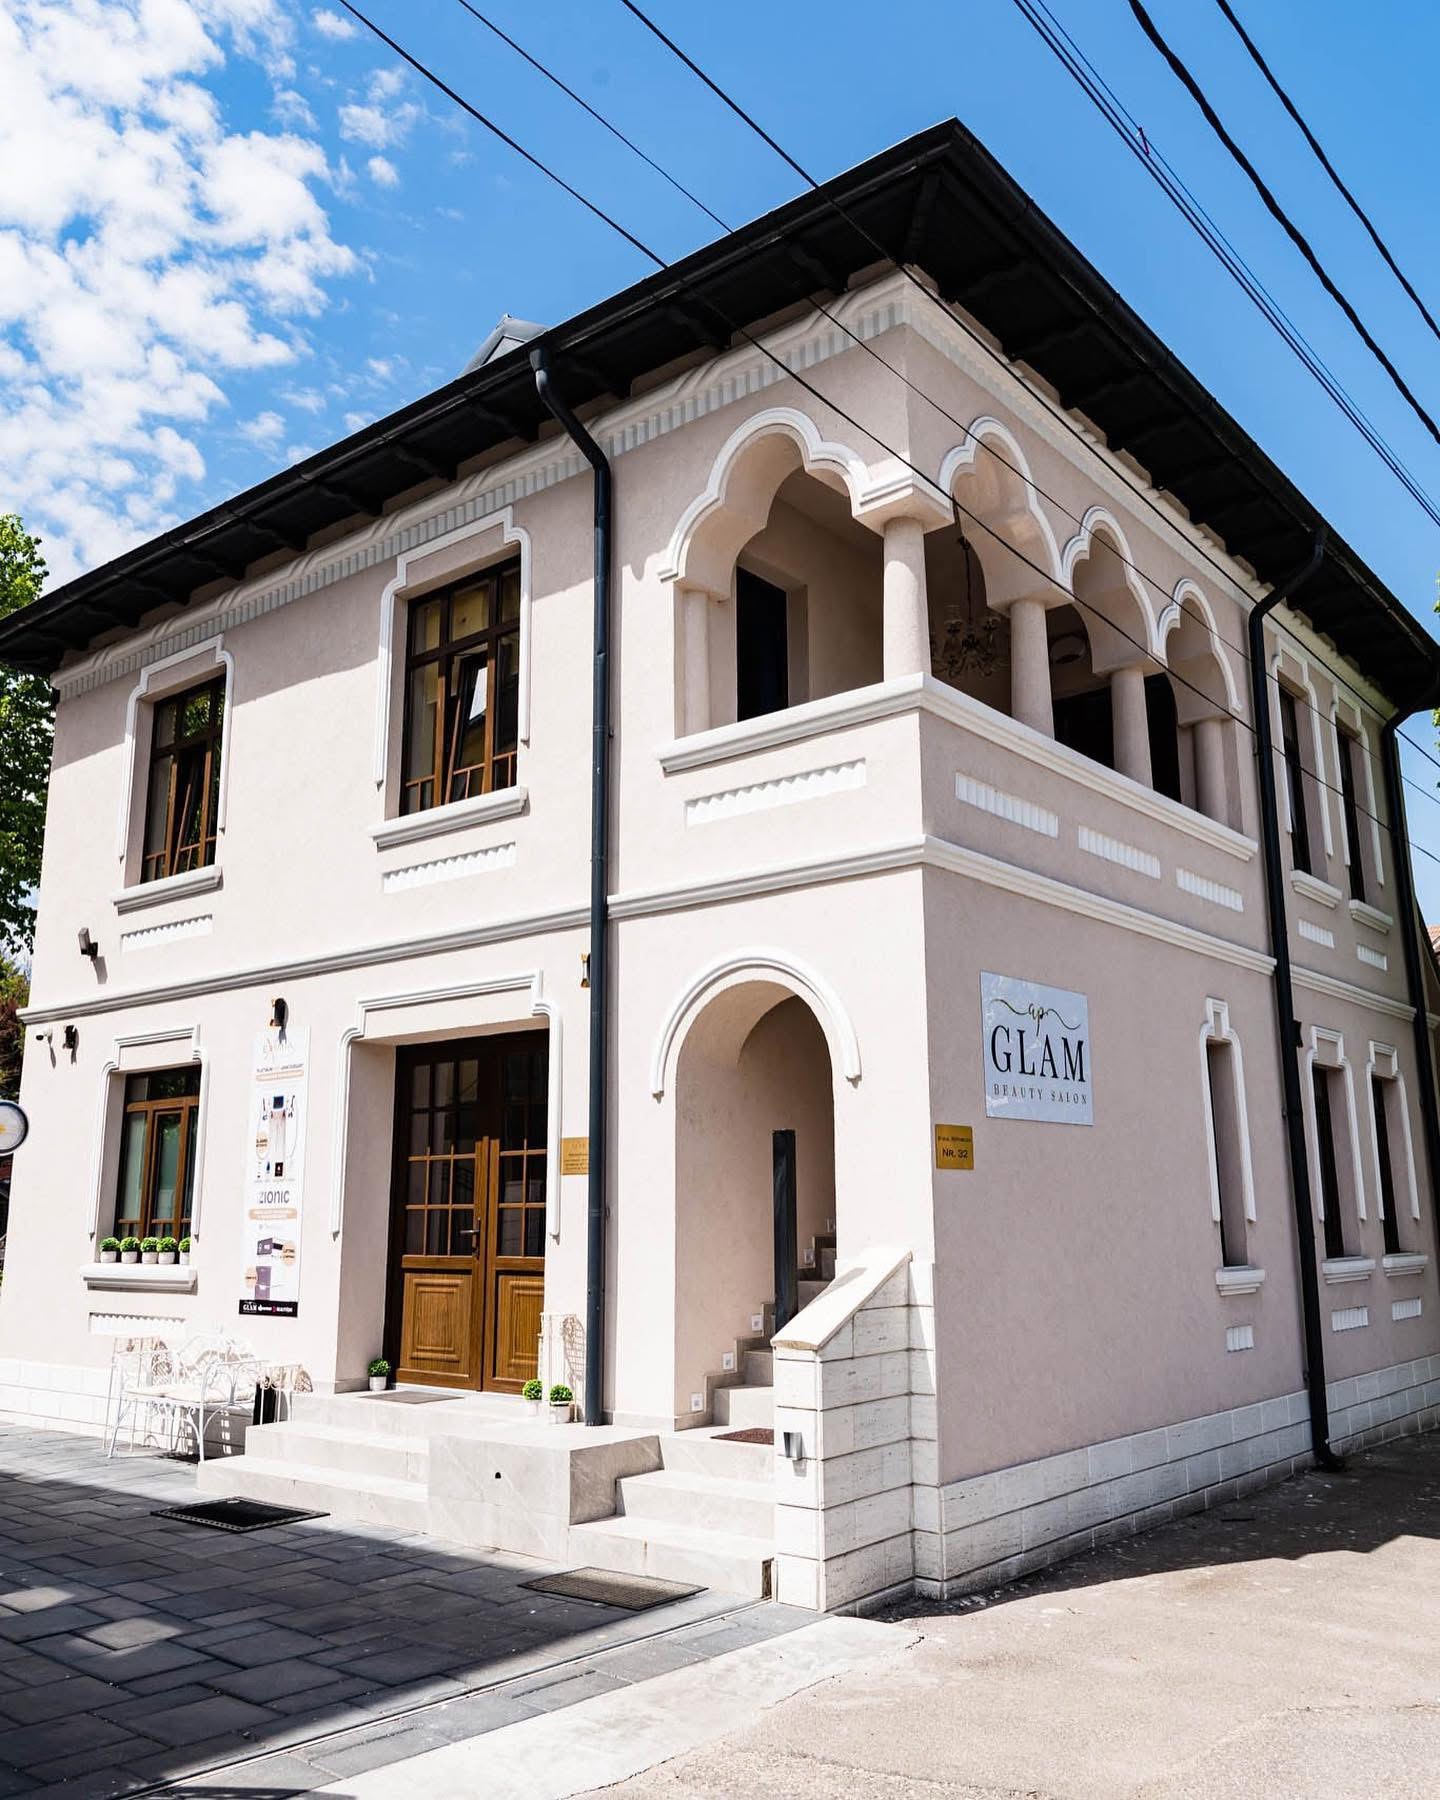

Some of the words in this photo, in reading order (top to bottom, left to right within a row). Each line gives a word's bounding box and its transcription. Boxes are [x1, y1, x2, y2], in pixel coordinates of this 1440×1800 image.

[991, 1025, 1086, 1083] GLAM
[993, 1083, 1043, 1101] BEAUTY
[1051, 1091, 1087, 1105] SALON
[942, 1148, 956, 1158] NR.
[957, 1149, 968, 1159] 32
